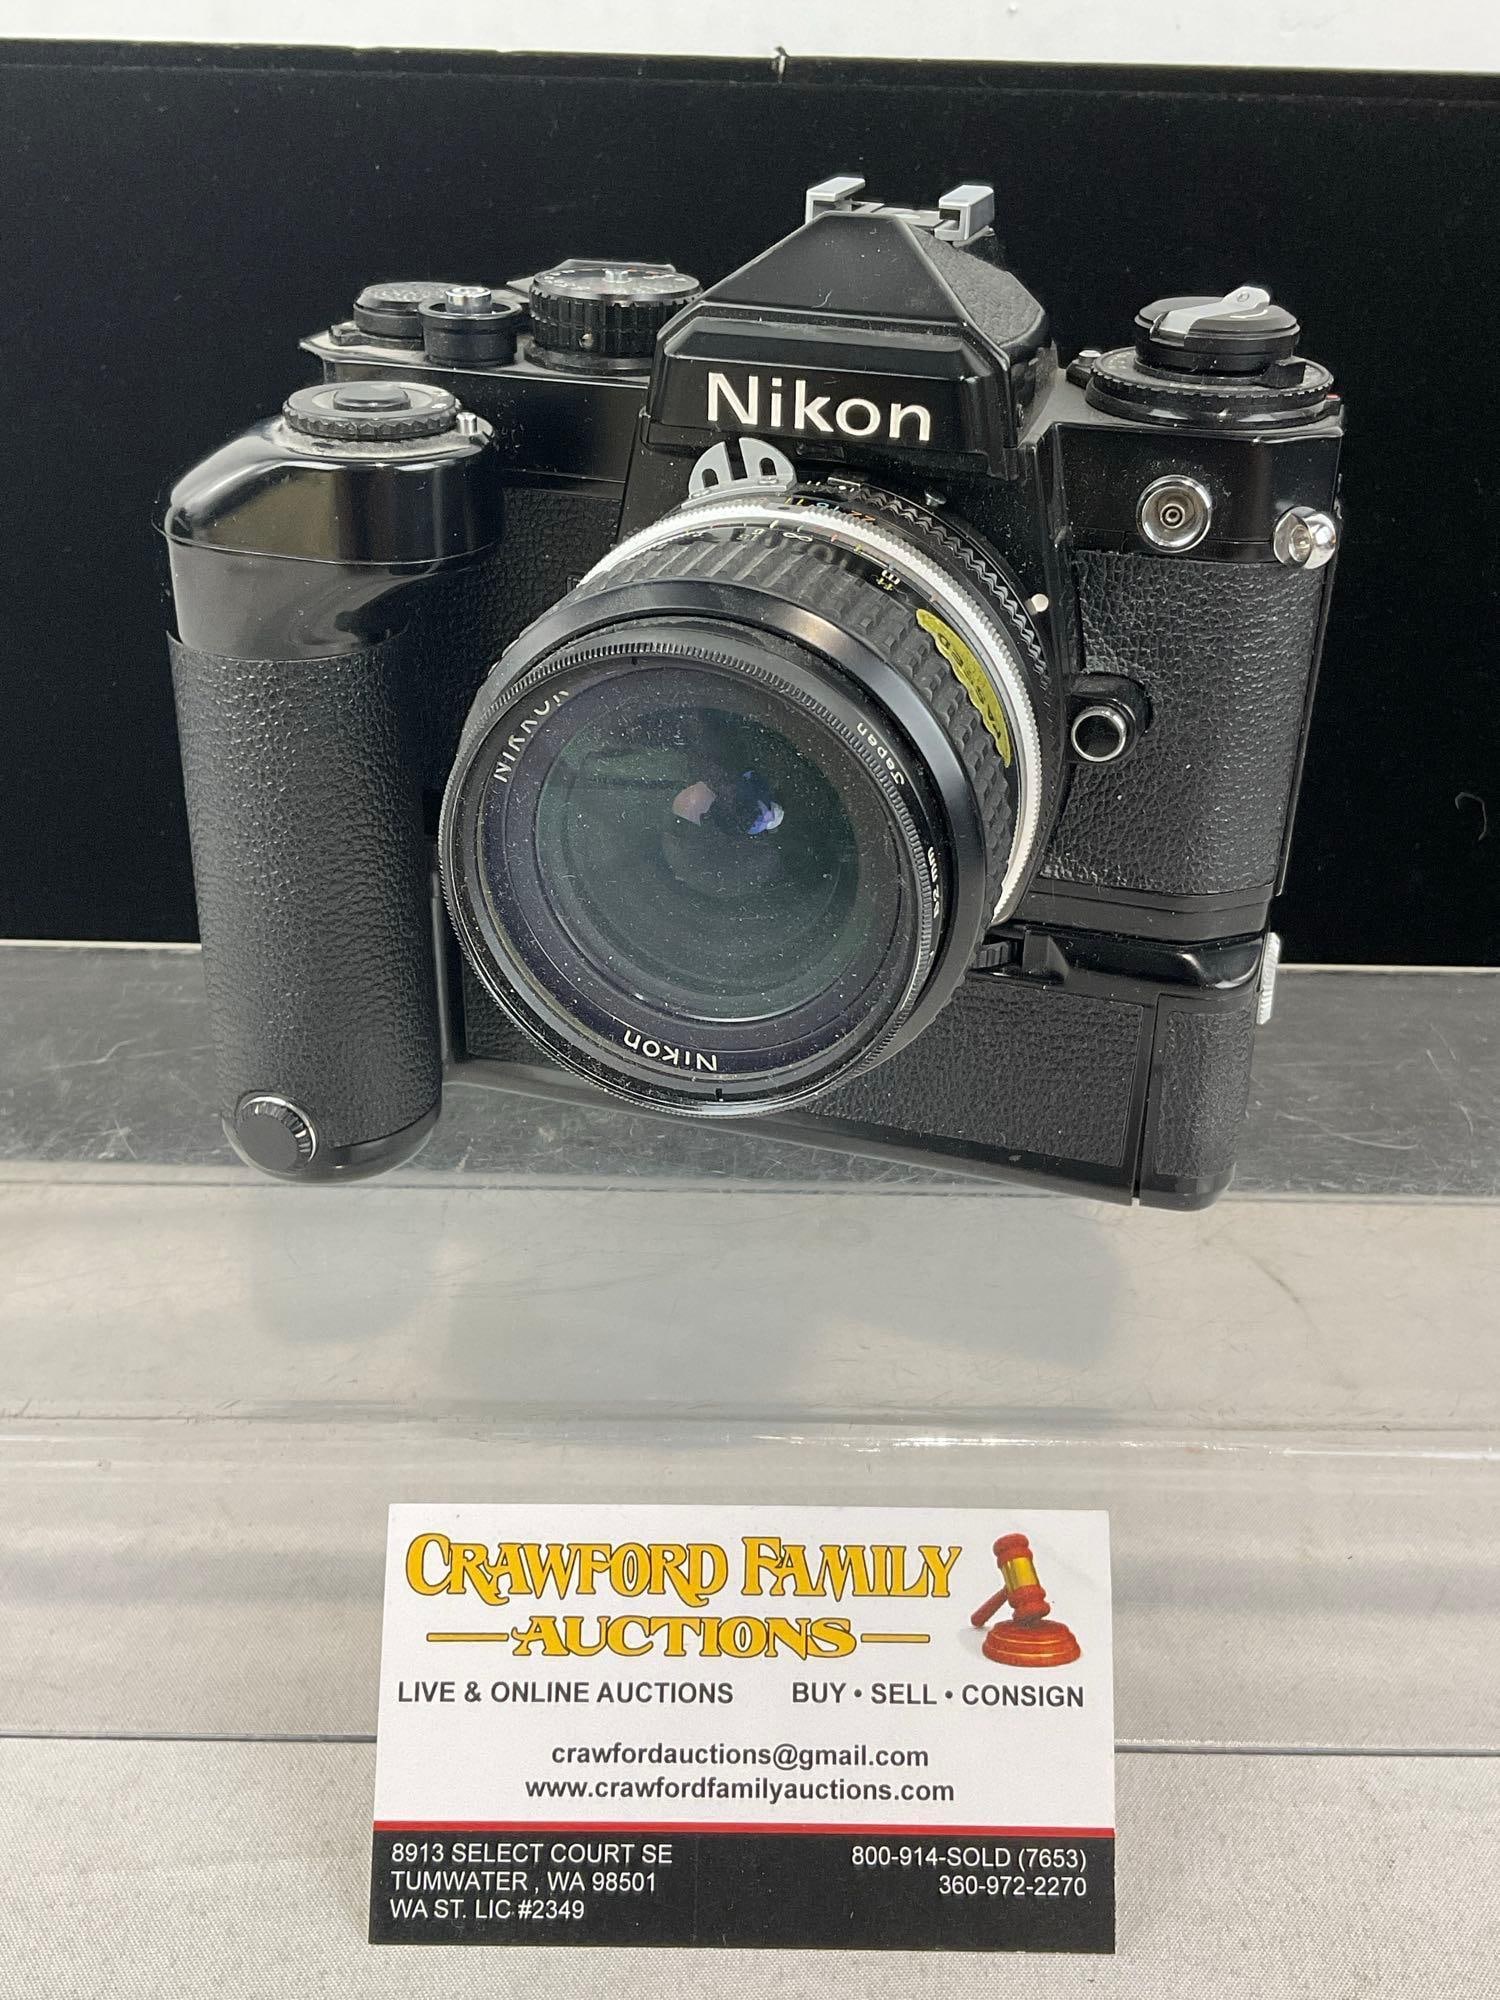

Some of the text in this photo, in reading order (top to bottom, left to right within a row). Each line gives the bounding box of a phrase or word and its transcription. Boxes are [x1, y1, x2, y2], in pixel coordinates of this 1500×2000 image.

[707, 372, 931, 441] Nikon
[857, 722, 905, 785] Japan
[406, 1533, 962, 1607] CRAWFORD FAMILY
[511, 1615, 857, 1660] AUCTIONS
[398, 1681, 734, 1704] LIVE & ONLINE AUCTIONS
[792, 1682, 1085, 1708] BUY SELL CONSIGN
[552, 1742, 929, 1771] crawfordauctions@gmail.com
[525, 1777, 955, 1805] www.crawfordfamilyauctions.com
[391, 1844, 673, 1865] 8913 SELECT COURT SE
[851, 1846, 1087, 1872] 800-914-SOLD (7653)
[391, 1871, 528, 1892] TUMWATER
[547, 1871, 585, 1892] WA
[592, 1871, 656, 1893] 98501
[939, 1875, 1087, 1897] 360-972-2270
[390, 1899, 585, 1920] WA ST. LIC #2349
